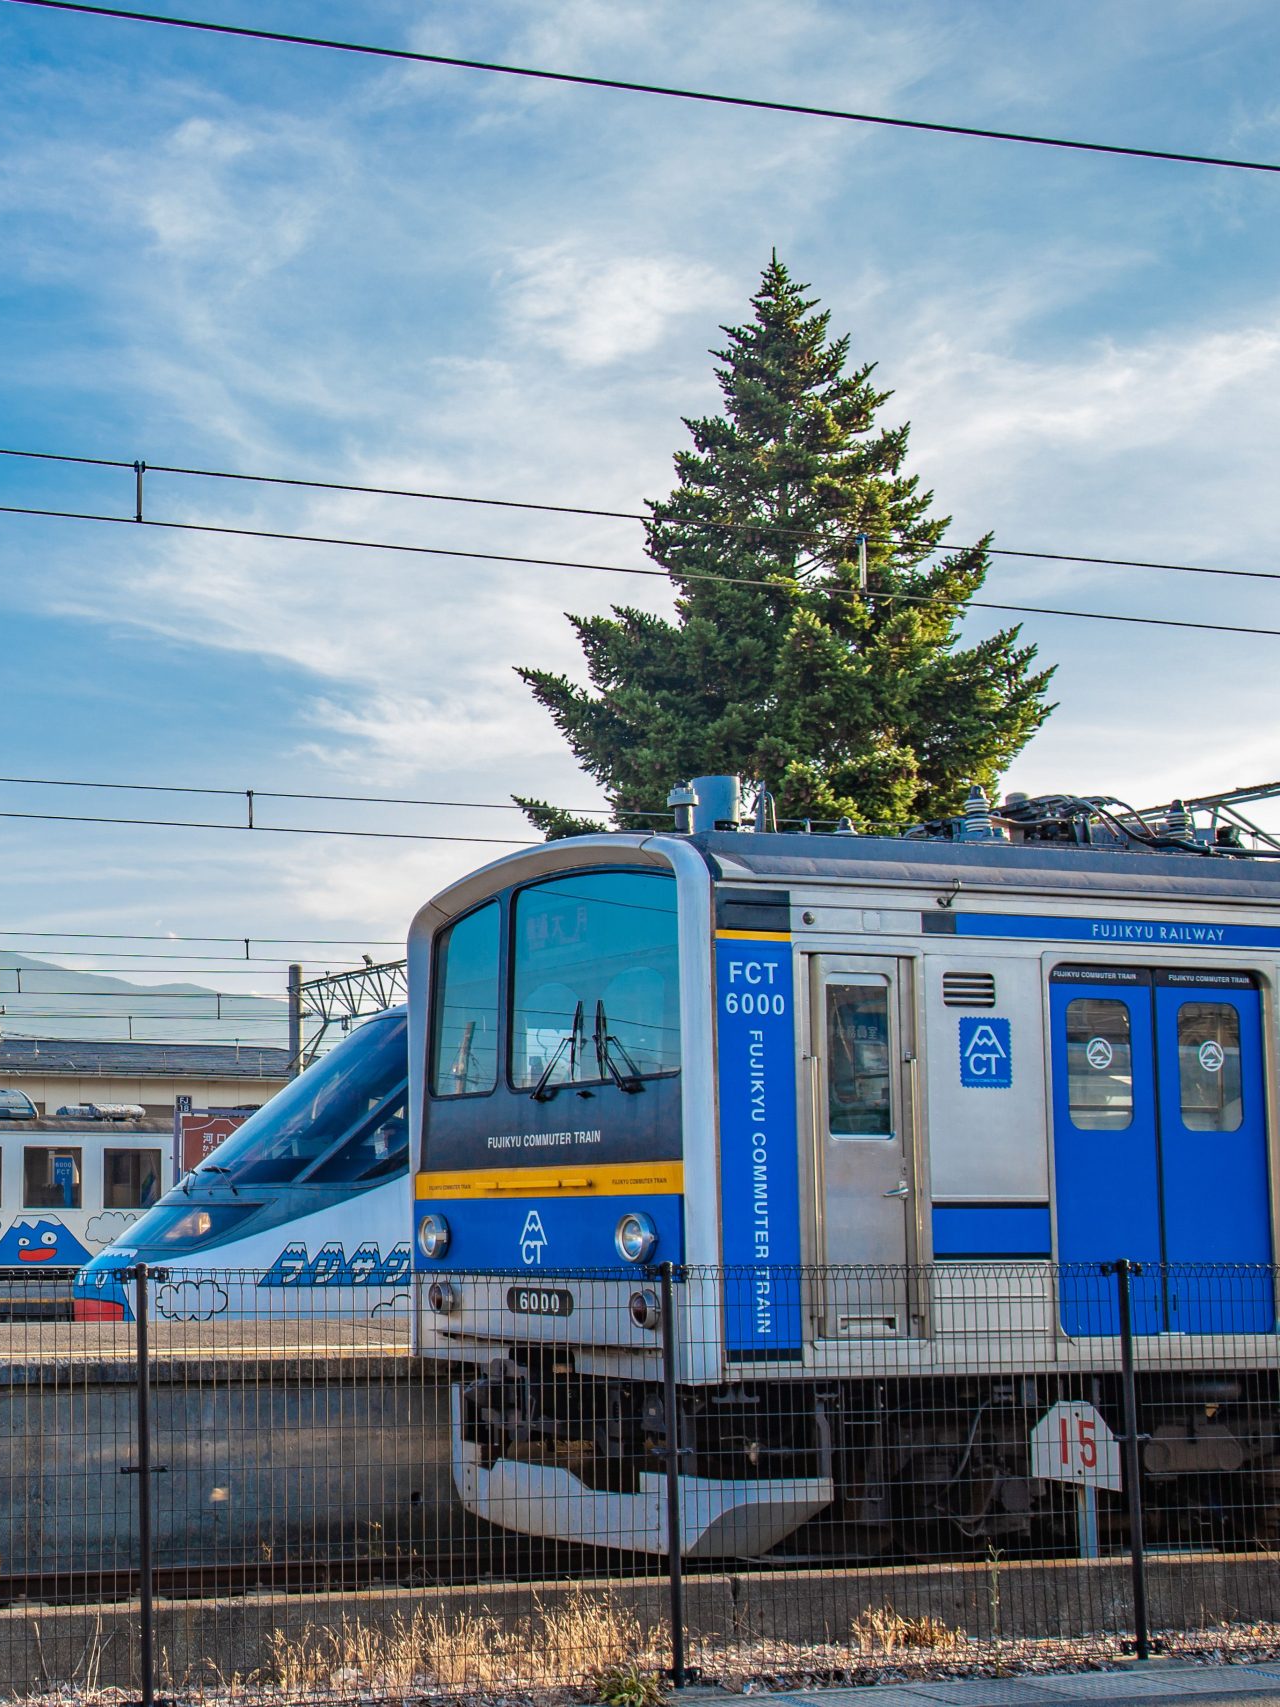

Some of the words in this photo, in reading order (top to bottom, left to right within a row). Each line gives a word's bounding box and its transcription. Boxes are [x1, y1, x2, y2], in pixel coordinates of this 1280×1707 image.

[1092, 924, 1154, 939] FUJIKYU
[1160, 927, 1225, 941] RAILWAY
[729, 961, 779, 985] FCT
[1053, 970, 1080, 978] FUJIKYU
[1168, 974, 1195, 982] FUJIKYU
[1196, 975, 1231, 983] COMMUTER
[1231, 976, 1250, 984] TRAIN
[725, 992, 785, 1016] 6000
[749, 1030, 766, 1121] FUJIKYU
[180, 1104, 189, 1112] 18
[487, 1135, 522, 1149] FUJIKYU
[523, 1132, 572, 1147] COMMUTER
[574, 1130, 601, 1144] TRAIN
[751, 1132, 770, 1259] COMMUTER
[519, 1291, 560, 1312] 6000
[755, 1266, 771, 1333] TRAIN
[1061, 1418, 1097, 1468] 15
